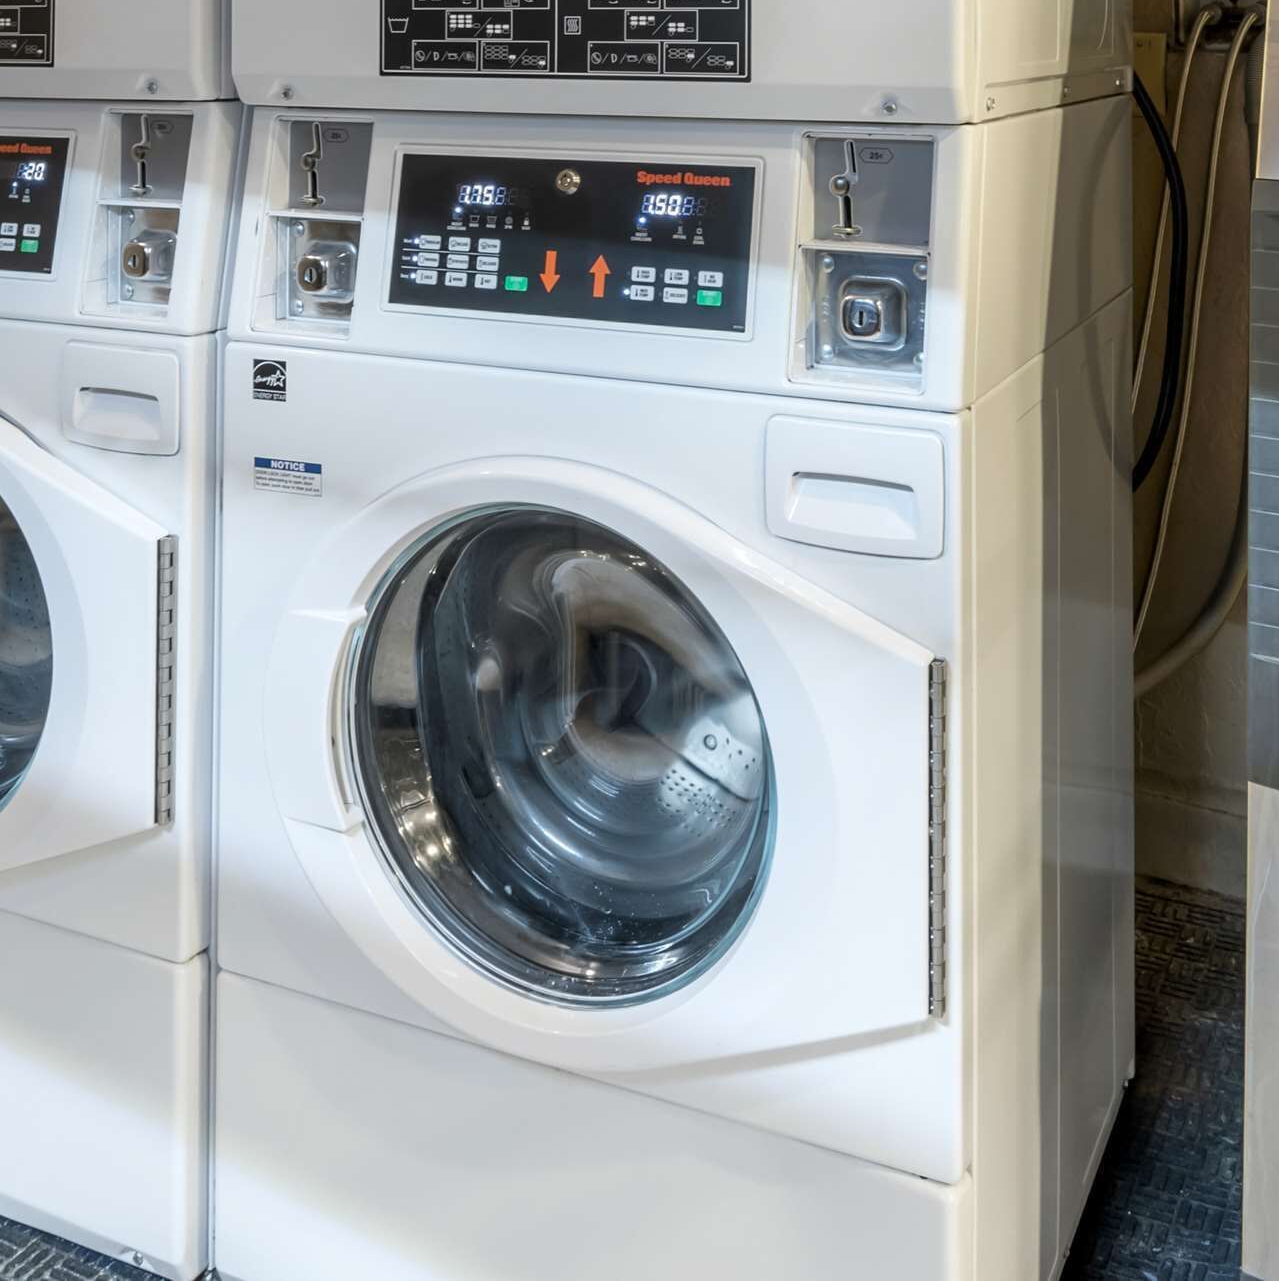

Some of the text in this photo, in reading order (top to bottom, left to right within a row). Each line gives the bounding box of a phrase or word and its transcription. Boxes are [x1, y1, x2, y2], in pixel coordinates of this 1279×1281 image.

[20, 143, 52, 154] Queen
[636, 170, 731, 187] Speed Queen
[270, 460, 306, 472] NOTICE
